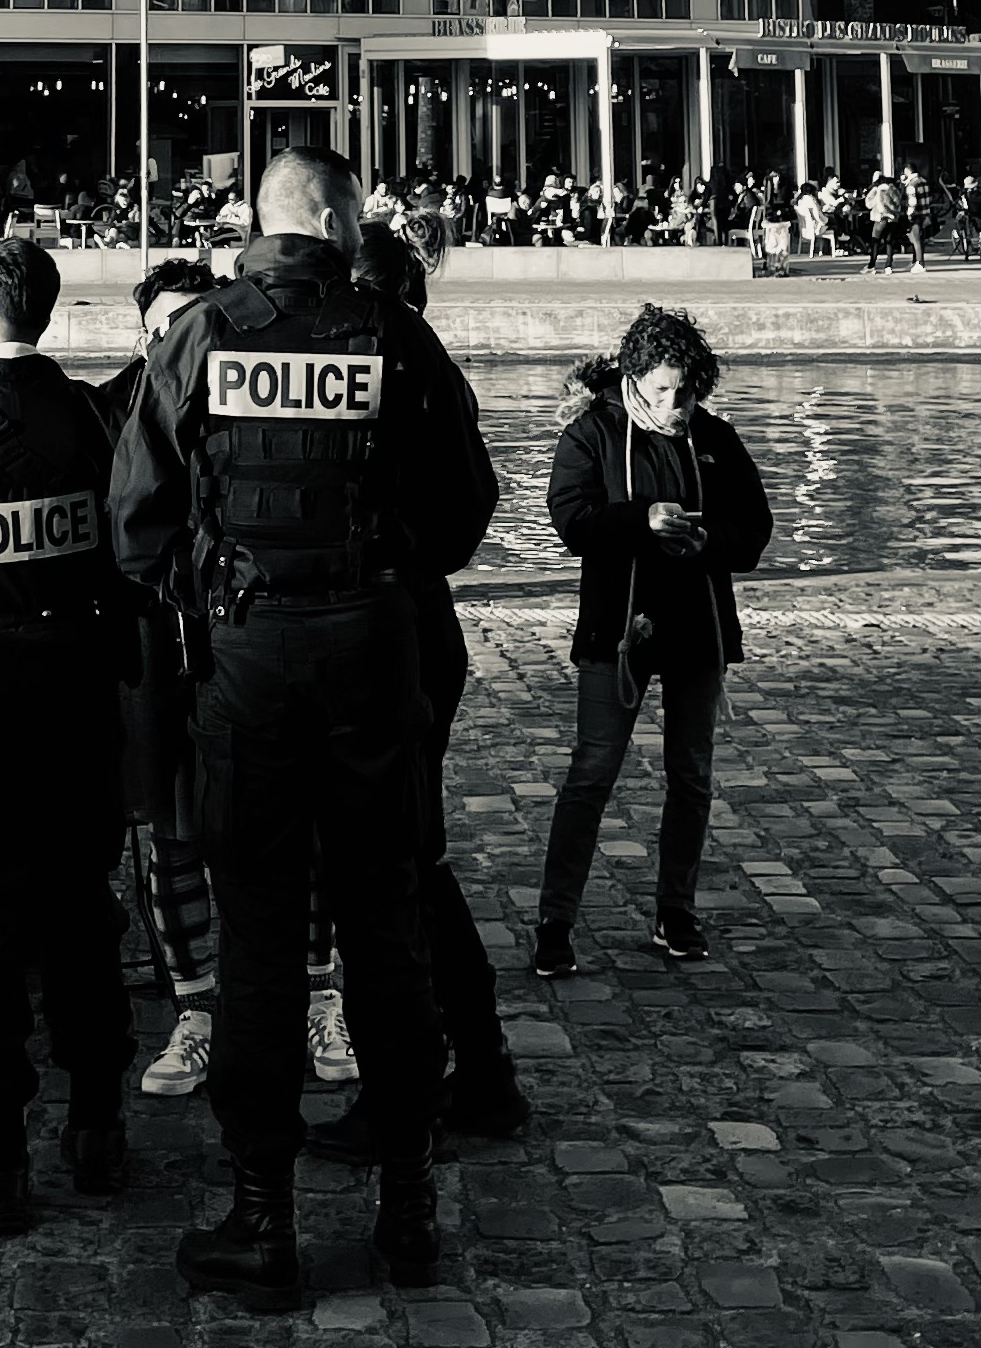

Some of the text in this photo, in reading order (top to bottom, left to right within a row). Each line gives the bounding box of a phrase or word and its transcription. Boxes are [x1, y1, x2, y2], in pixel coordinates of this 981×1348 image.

[758, 18, 816, 38] BISTRO
[263, 54, 302, 88] Grands
[287, 60, 332, 90] Moulins
[218, 360, 372, 411] POLICE
